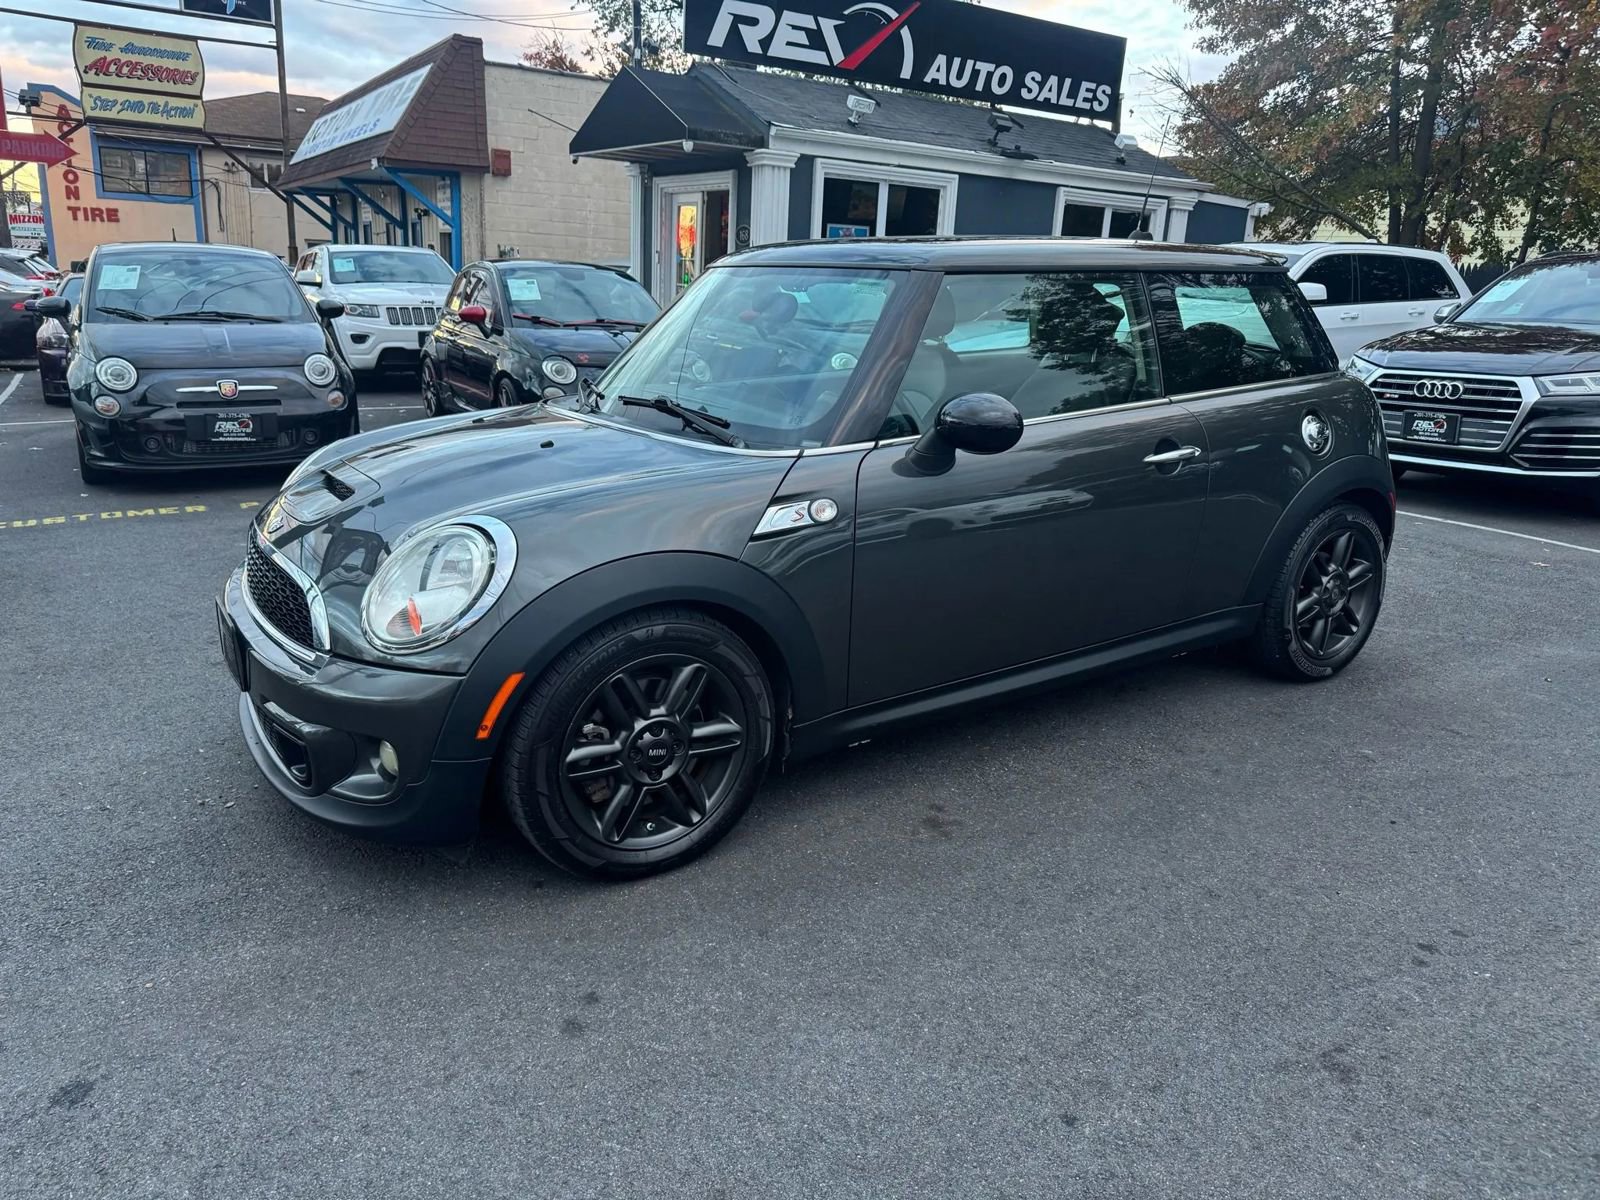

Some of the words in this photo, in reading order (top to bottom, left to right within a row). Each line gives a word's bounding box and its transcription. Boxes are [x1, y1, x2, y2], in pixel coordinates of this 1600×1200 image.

[83, 56, 199, 85] ACCESSORIES
[923, 54, 1014, 96] AUTO
[1021, 71, 1112, 112] SALES
[66, 206, 120, 223] TIRE
[648, 748, 667, 757] MINI
